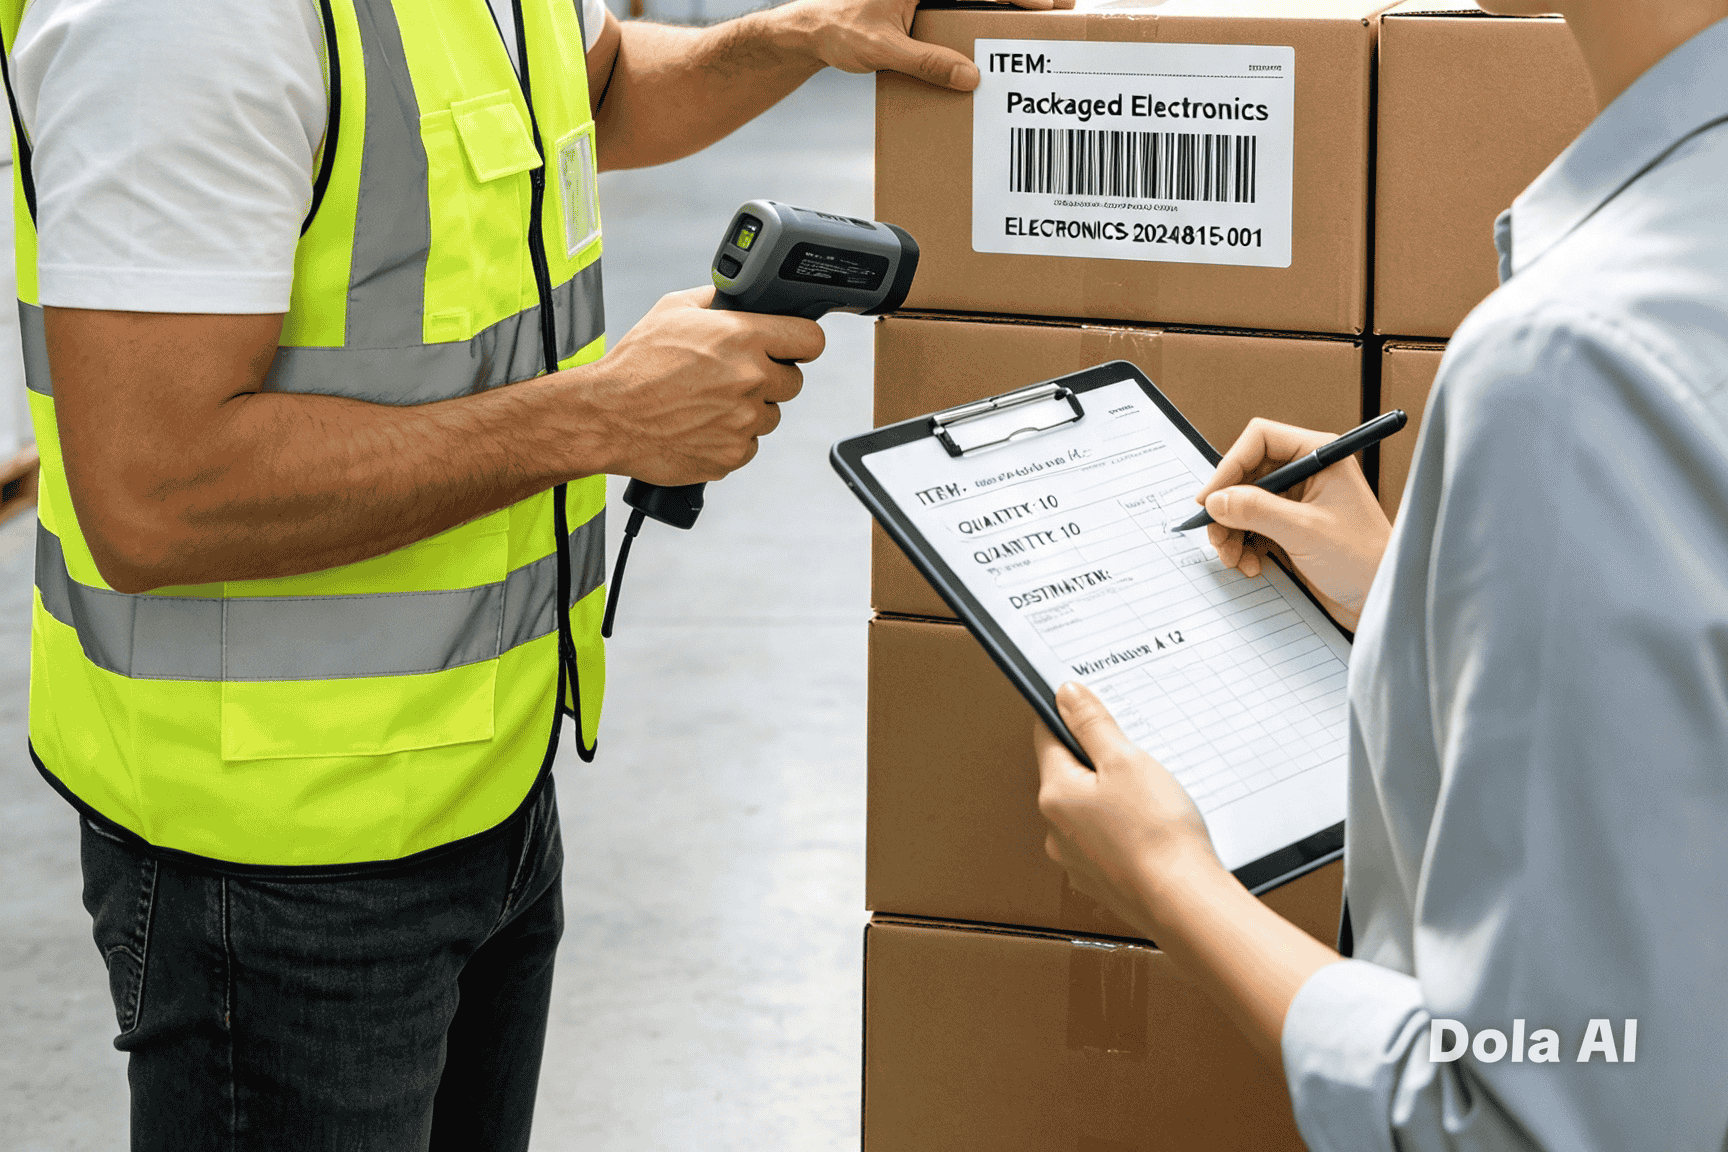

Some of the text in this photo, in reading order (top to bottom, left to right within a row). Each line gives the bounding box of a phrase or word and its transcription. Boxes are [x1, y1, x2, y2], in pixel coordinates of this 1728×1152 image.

[989, 53, 1052, 74] ITEM:
[1007, 92, 1269, 122] Packaged Electronics
[1060, 522, 1081, 538] 10
